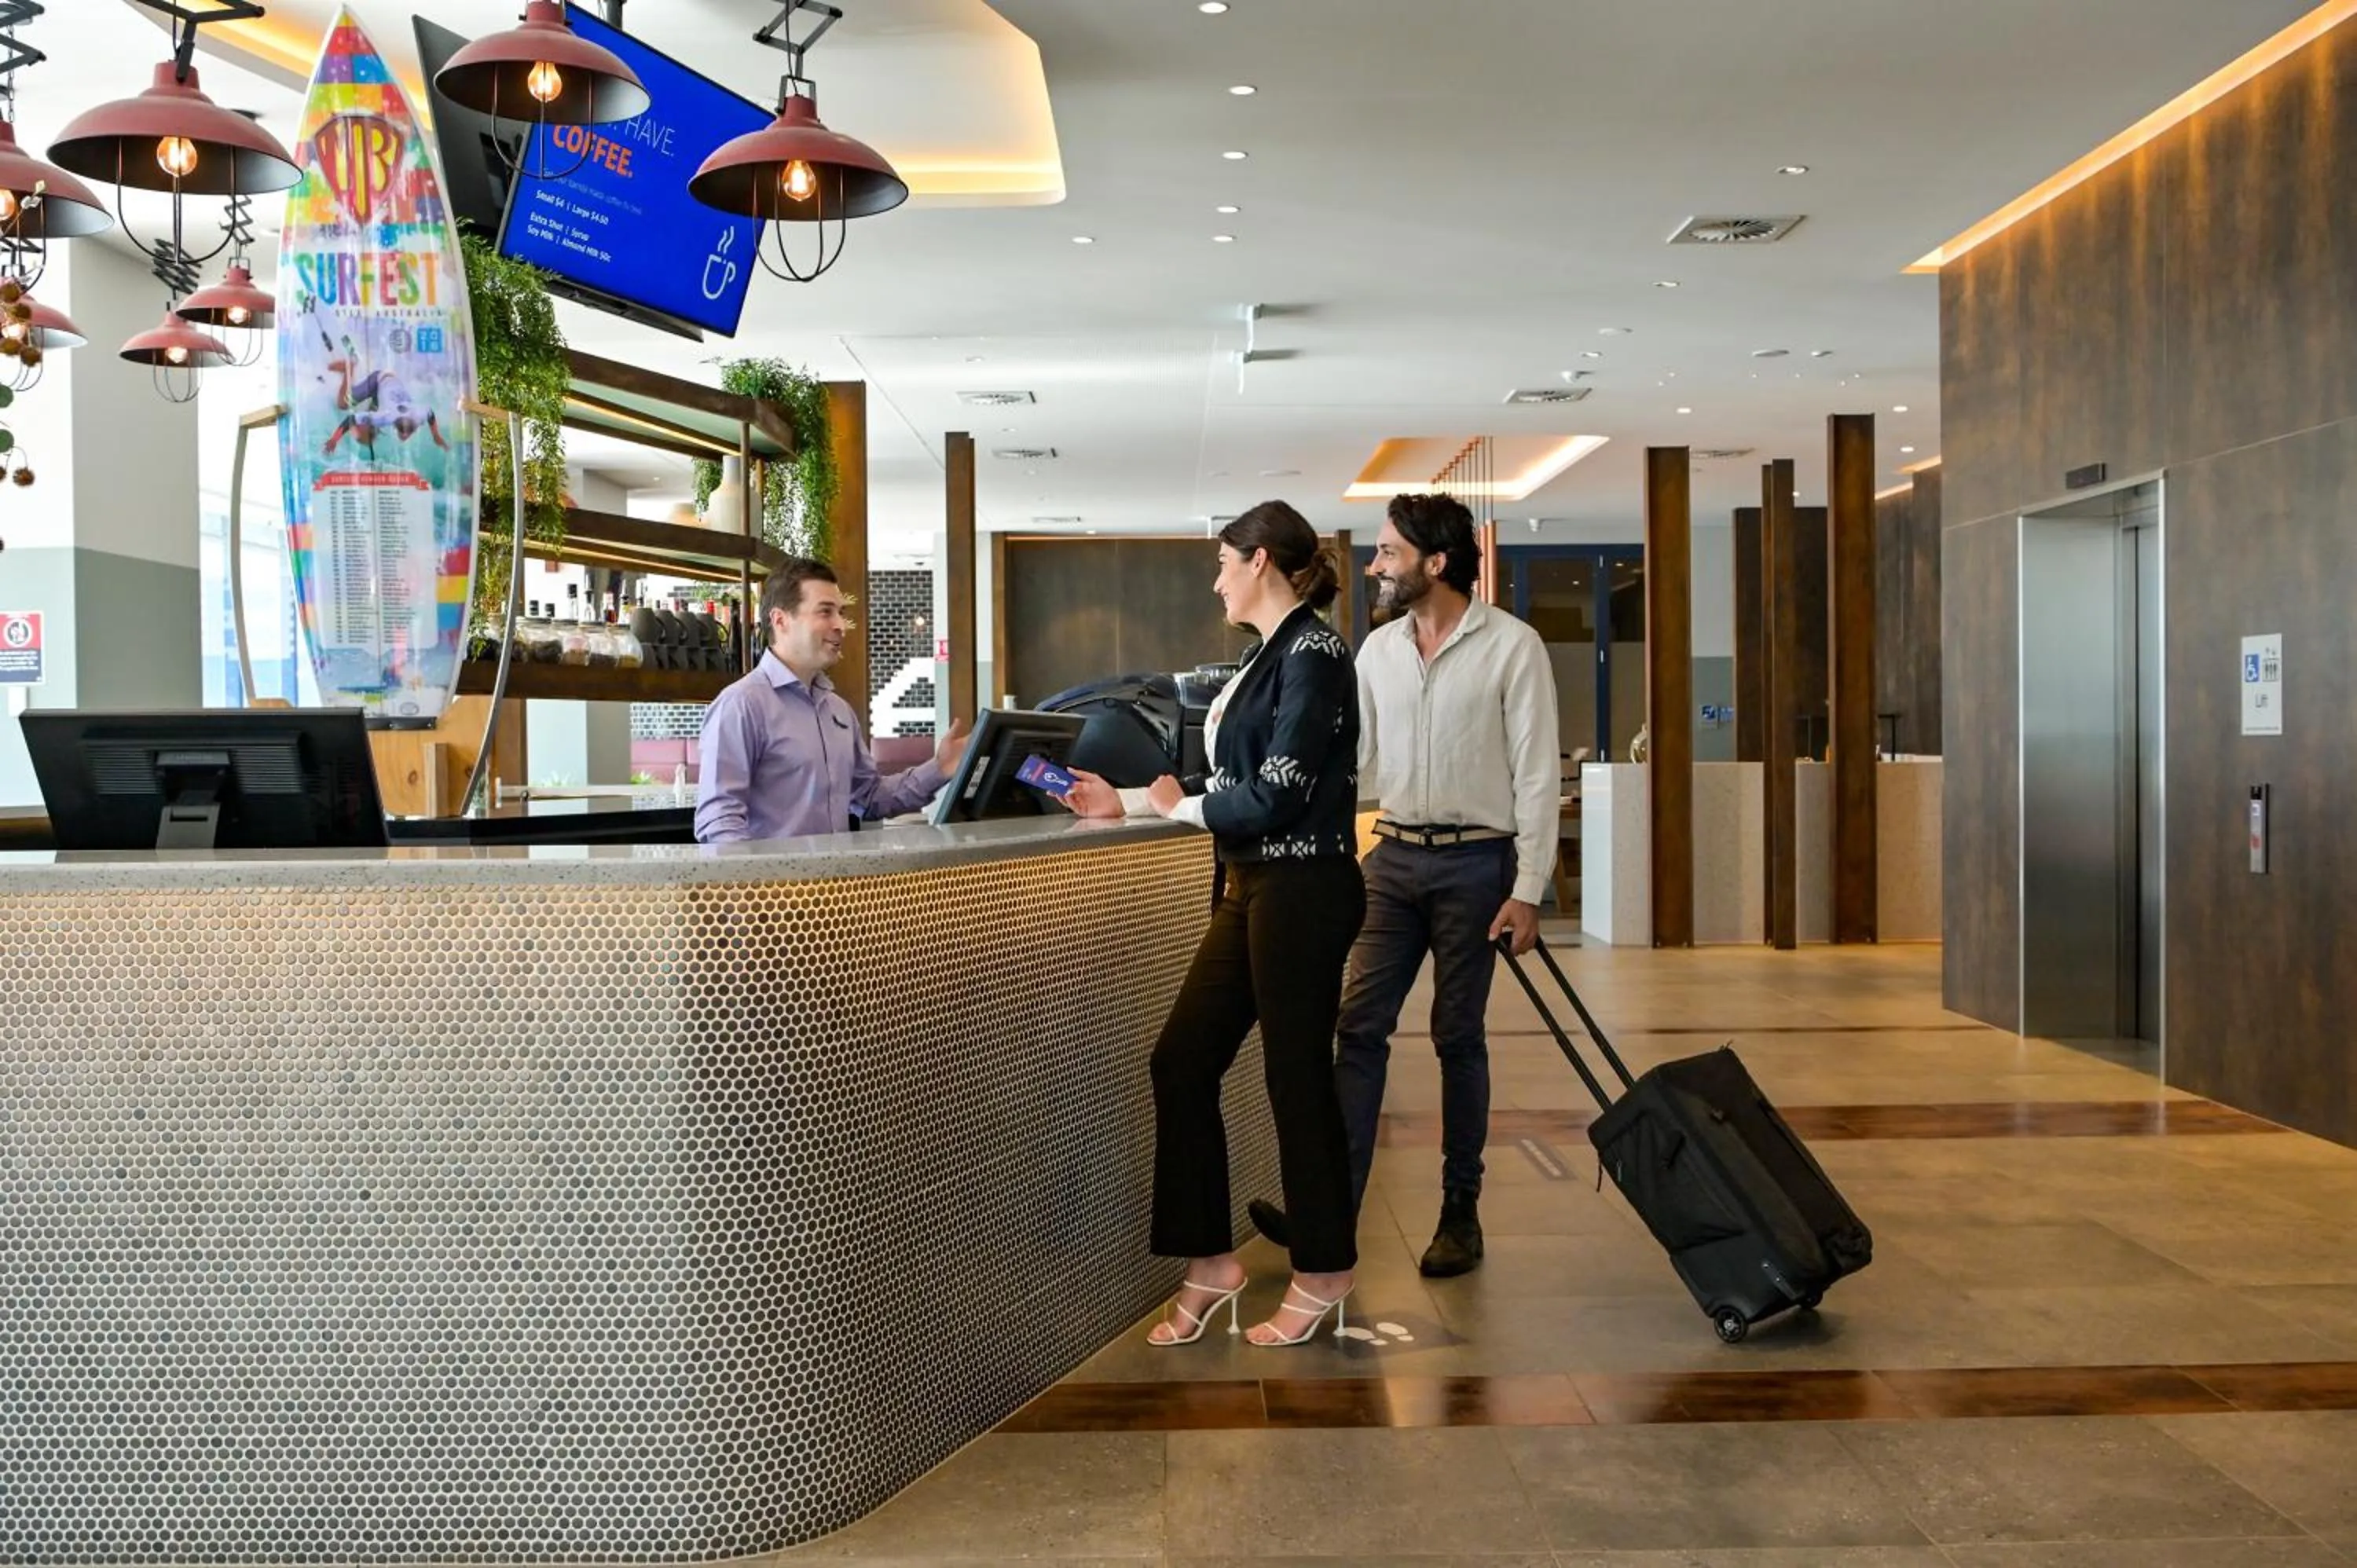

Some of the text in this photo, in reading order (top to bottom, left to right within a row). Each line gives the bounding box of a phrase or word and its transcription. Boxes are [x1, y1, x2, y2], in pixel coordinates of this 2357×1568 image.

[553, 125, 633, 178] COFFEE.
[530, 211, 548, 225] Extra
[536, 190, 555, 203] Small
[572, 204, 589, 218] Large
[527, 225, 540, 236] Soy
[294, 252, 439, 306] SURFEST
